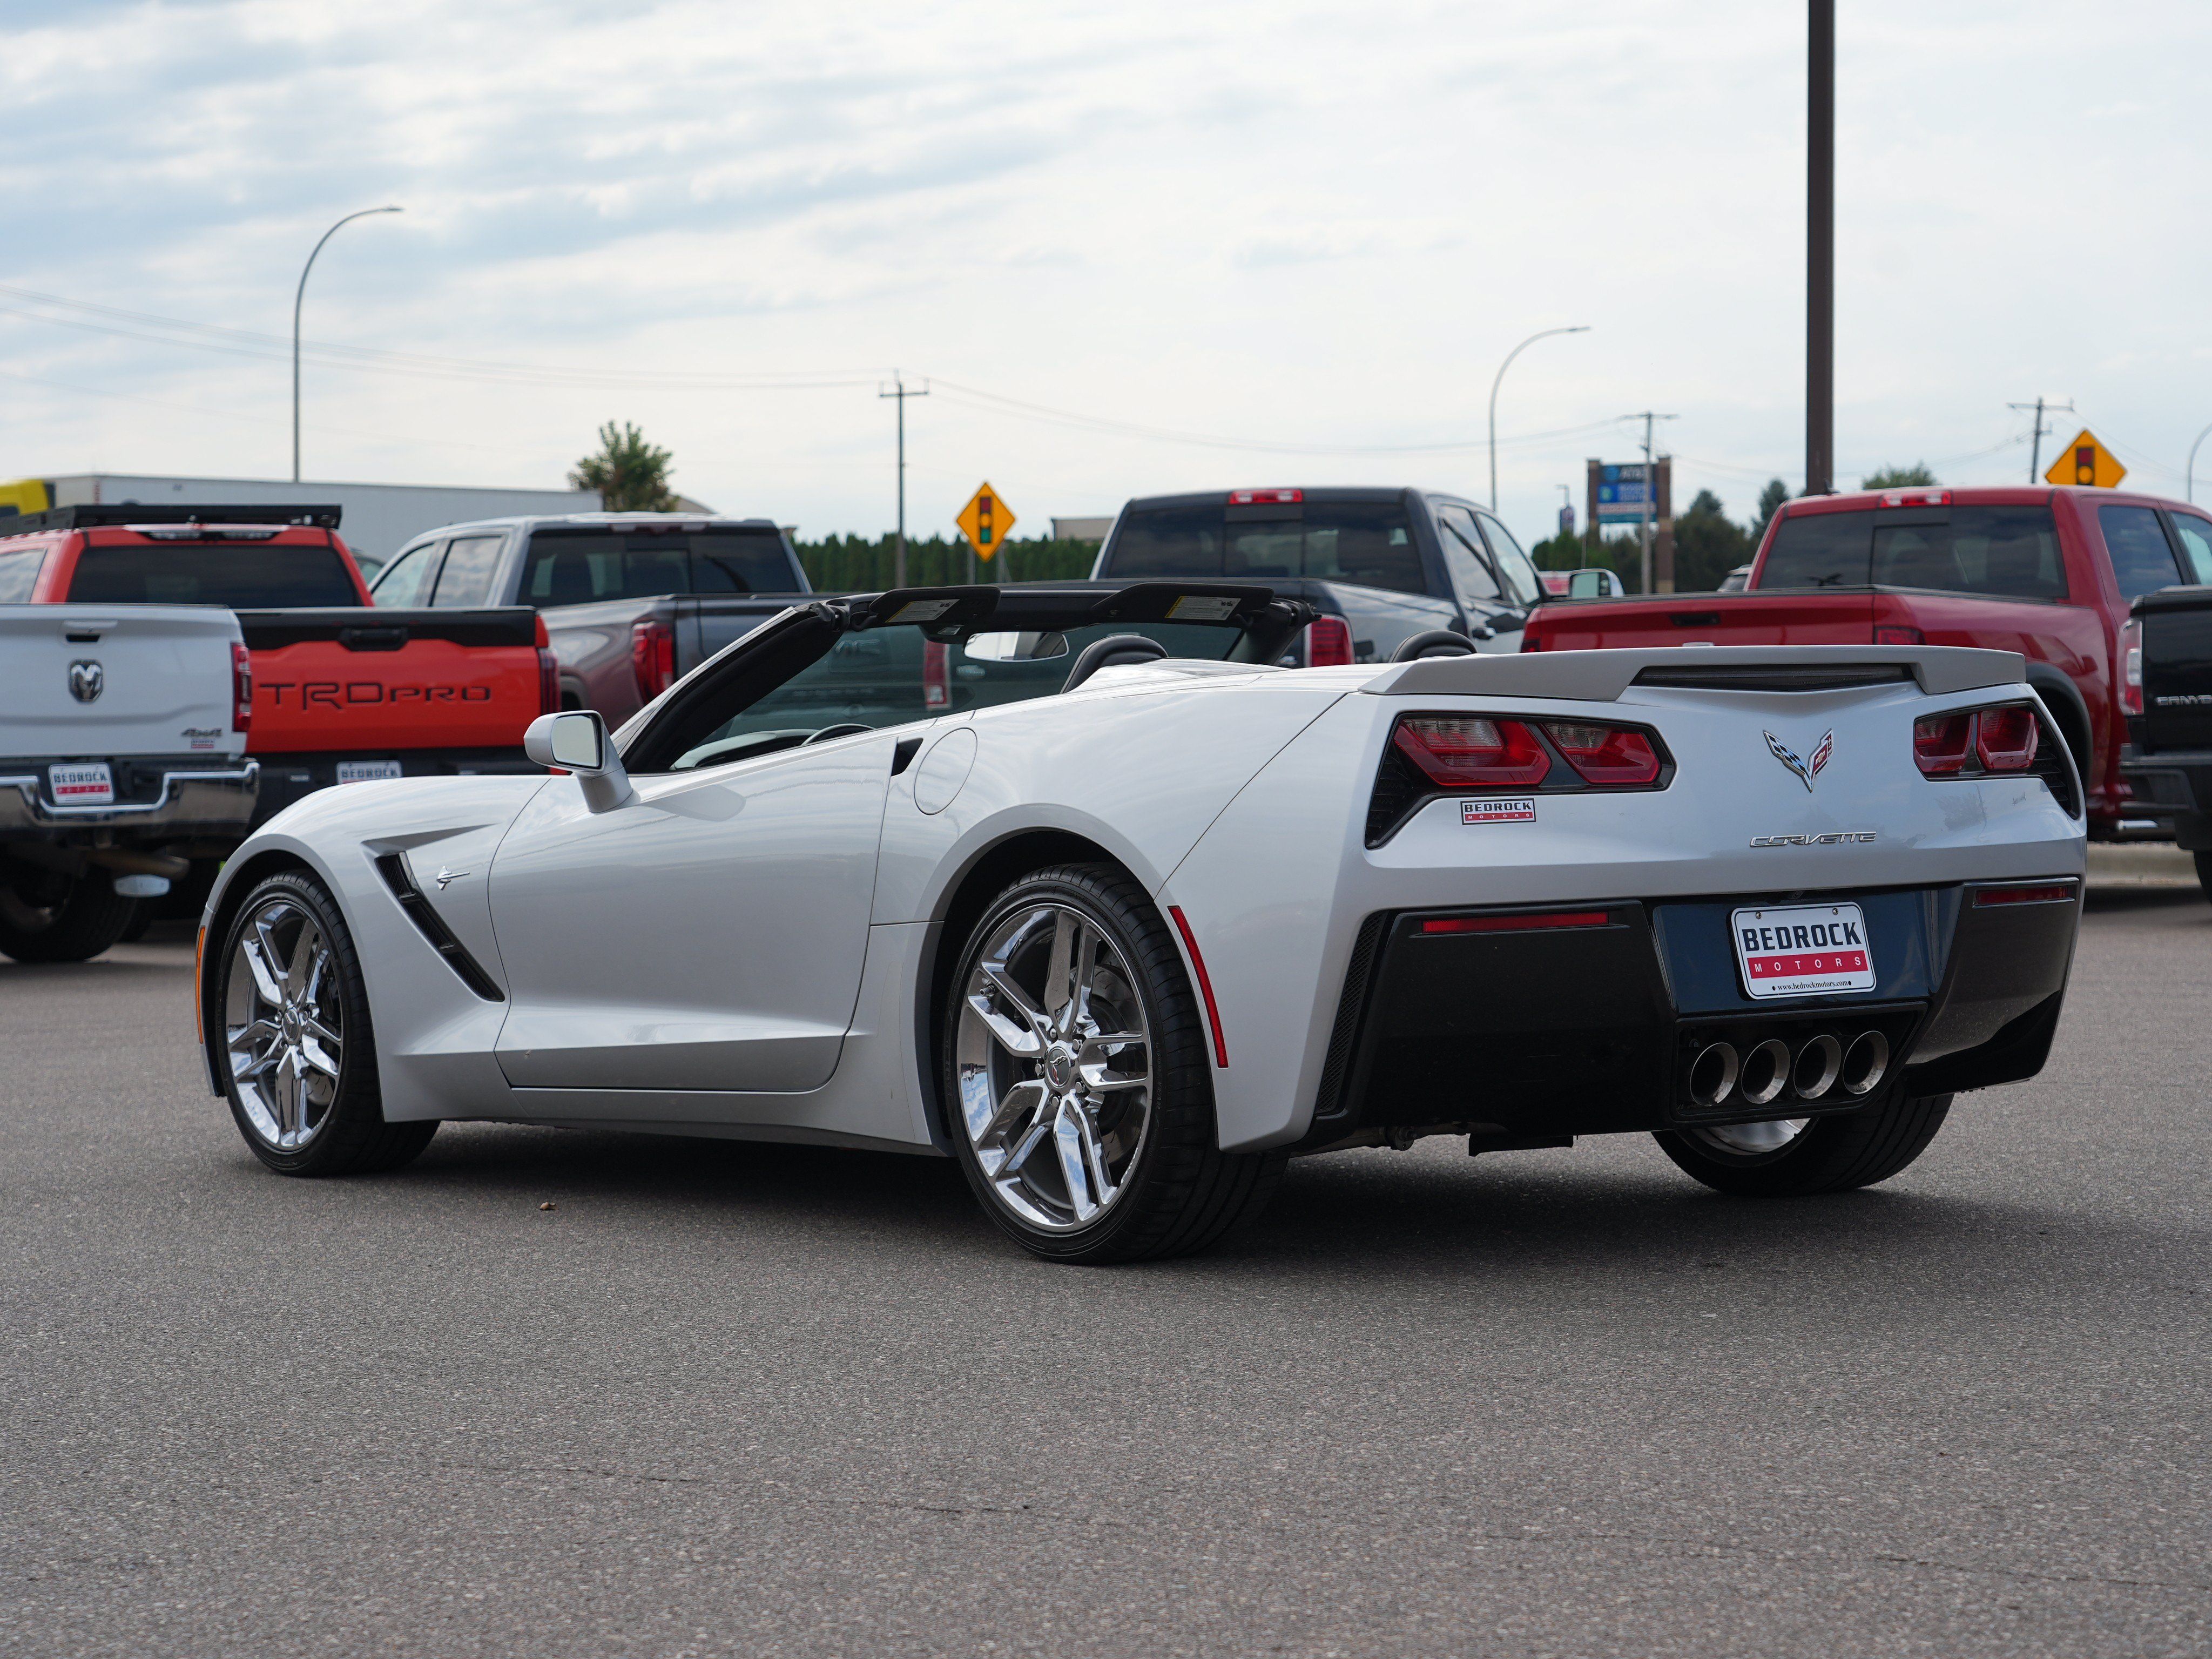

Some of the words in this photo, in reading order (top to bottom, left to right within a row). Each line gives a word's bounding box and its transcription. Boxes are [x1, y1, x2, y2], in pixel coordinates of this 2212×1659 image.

[259, 683, 383, 710] TRD
[390, 686, 490, 702] PRO
[53, 771, 108, 783] BEDROCK
[341, 768, 397, 778] BEDROCK
[1464, 802, 1532, 812] BEDROCK
[1750, 832, 1877, 847] CORVETTE
[1742, 922, 1862, 952] BEDROCK
[1755, 956, 1861, 973] MOTORS
[1777, 980, 1848, 991] www.bedrockmotors.com
